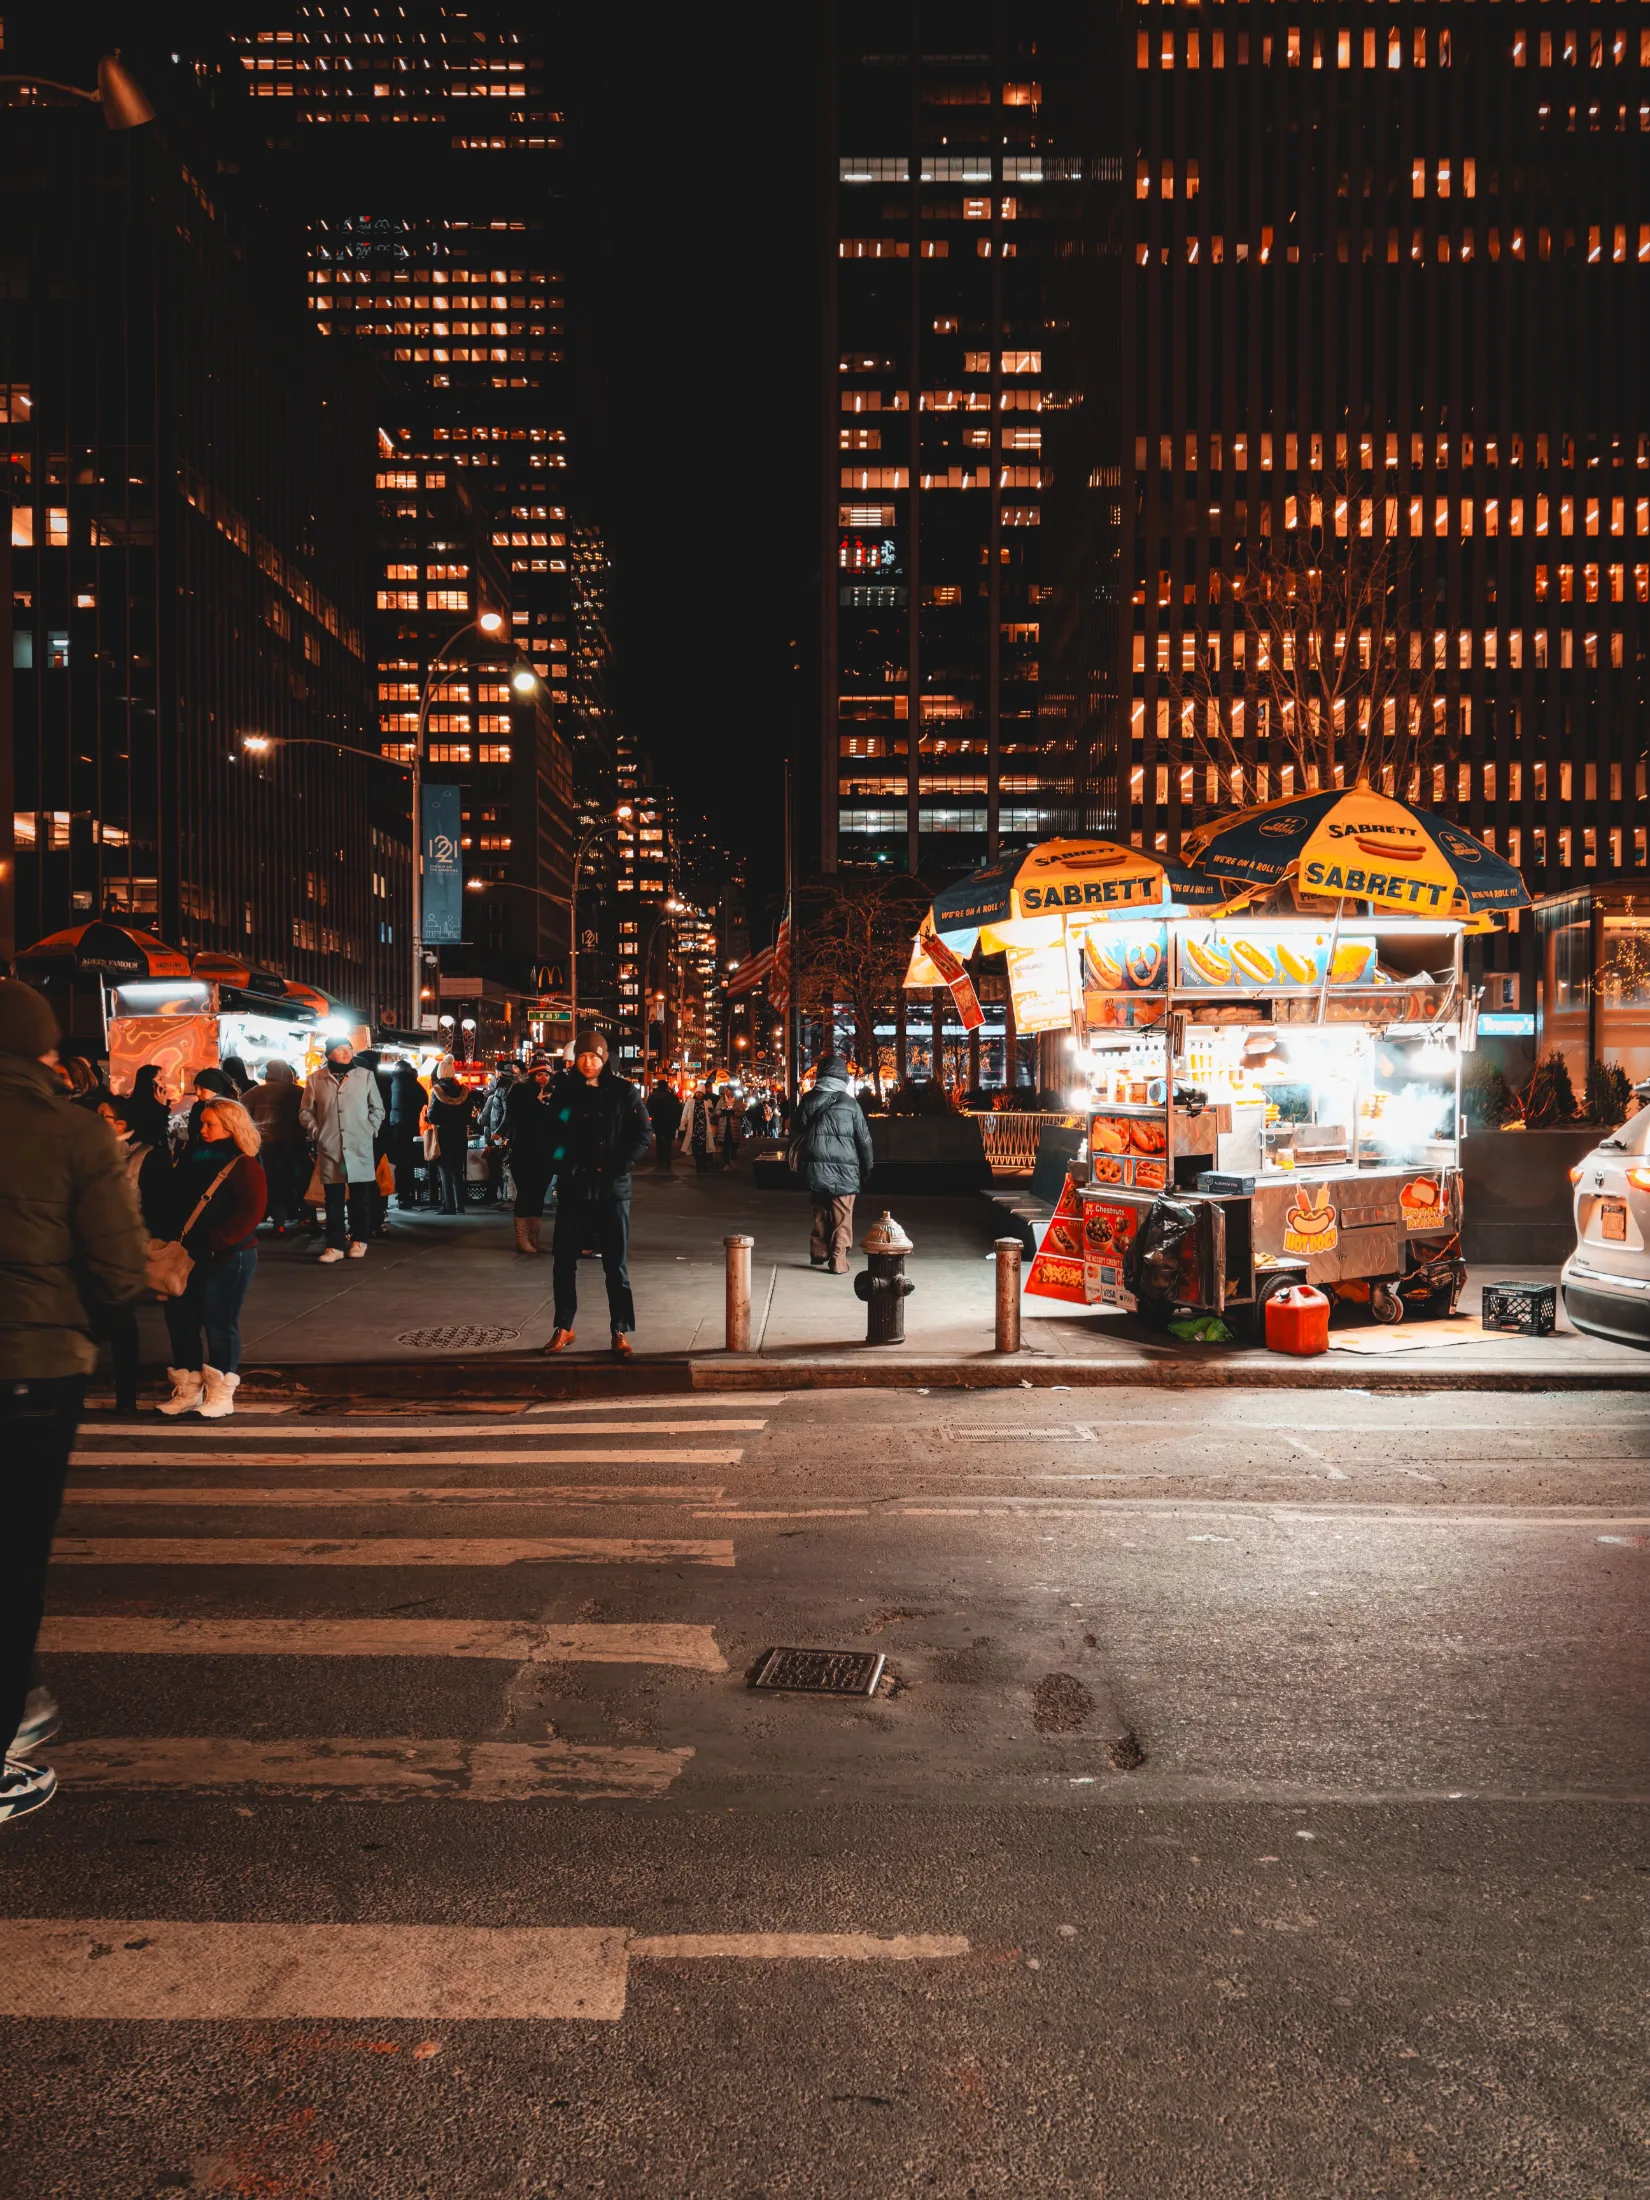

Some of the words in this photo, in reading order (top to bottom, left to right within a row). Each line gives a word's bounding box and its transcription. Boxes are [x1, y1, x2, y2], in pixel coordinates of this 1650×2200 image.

[1327, 823, 1418, 839] SABRETT
[1034, 848, 1116, 867] SABRETT
[1213, 854, 1237, 866] WE'RE
[1237, 858, 1248, 866] ON
[1249, 861, 1254, 869] A
[1256, 862, 1275, 874] ROLL
[1306, 862, 1448, 906] SABRETT
[1022, 876, 1156, 910] SABRETT
[941, 909, 964, 919] WE'RE
[965, 907, 975, 916] ON
[976, 906, 980, 914] A
[983, 903, 998, 913] ROLL
[108, 959, 138, 969] FAMOUS
[1095, 1205, 1125, 1216] Chestnuts
[1408, 1216, 1443, 1229] KNISH
[1285, 1230, 1308, 1253] HOT
[1309, 1227, 1337, 1253] DOGS
[1103, 1289, 1115, 1298] VISA
